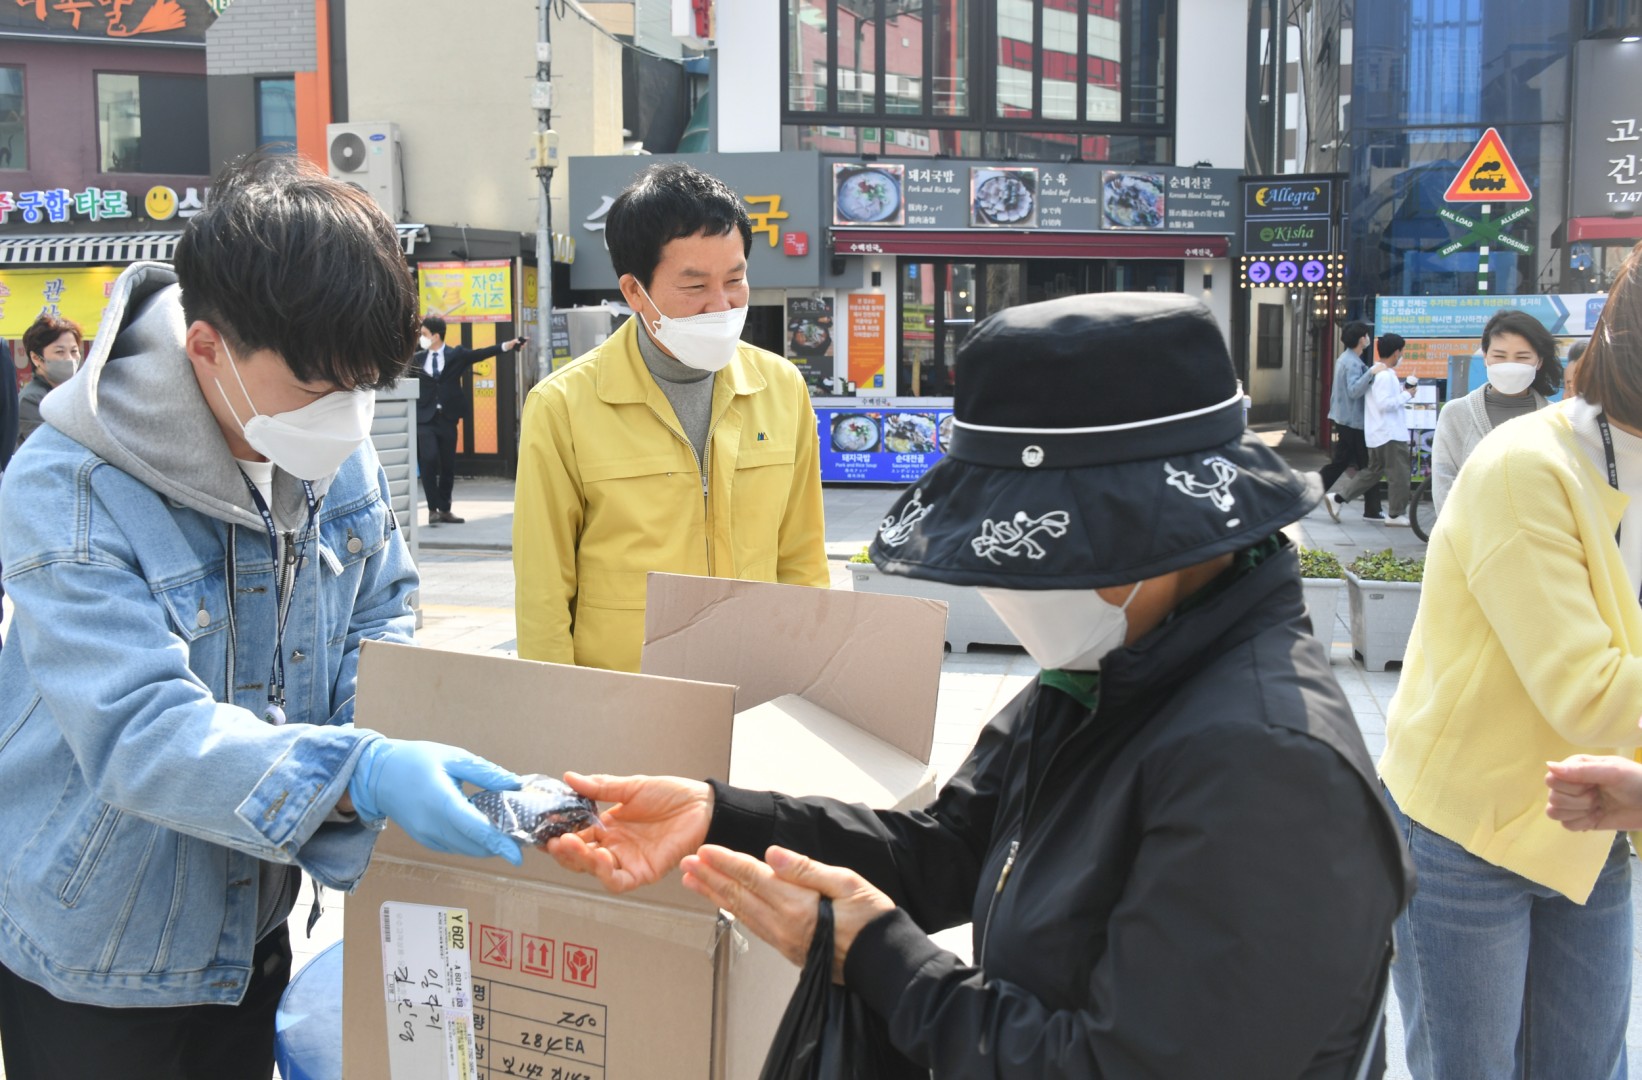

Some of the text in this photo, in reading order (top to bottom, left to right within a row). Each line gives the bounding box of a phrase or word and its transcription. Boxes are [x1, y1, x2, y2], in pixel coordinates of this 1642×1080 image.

[908, 168, 954, 183] 돼지국밥
[1169, 176, 1212, 190] 순대전골
[908, 185, 920, 193] Pork
[947, 186, 961, 195] Soup
[1265, 187, 1316, 206] Allegra
[17, 188, 70, 222] 궁합
[74, 187, 132, 221] 타로
[1274, 224, 1314, 242] Kisha
[1440, 209, 1530, 252] RAIL LOAD CROSSING
[1442, 206, 1530, 256] KISHA ALLEGRA
[472, 272, 504, 291] 자연
[472, 293, 504, 309] 치즈
[1381, 307, 1395, 315] 하고
[842, 454, 871, 463] 돼지국밥
[896, 454, 924, 464] 순대전골
[452, 925, 465, 950] 602
